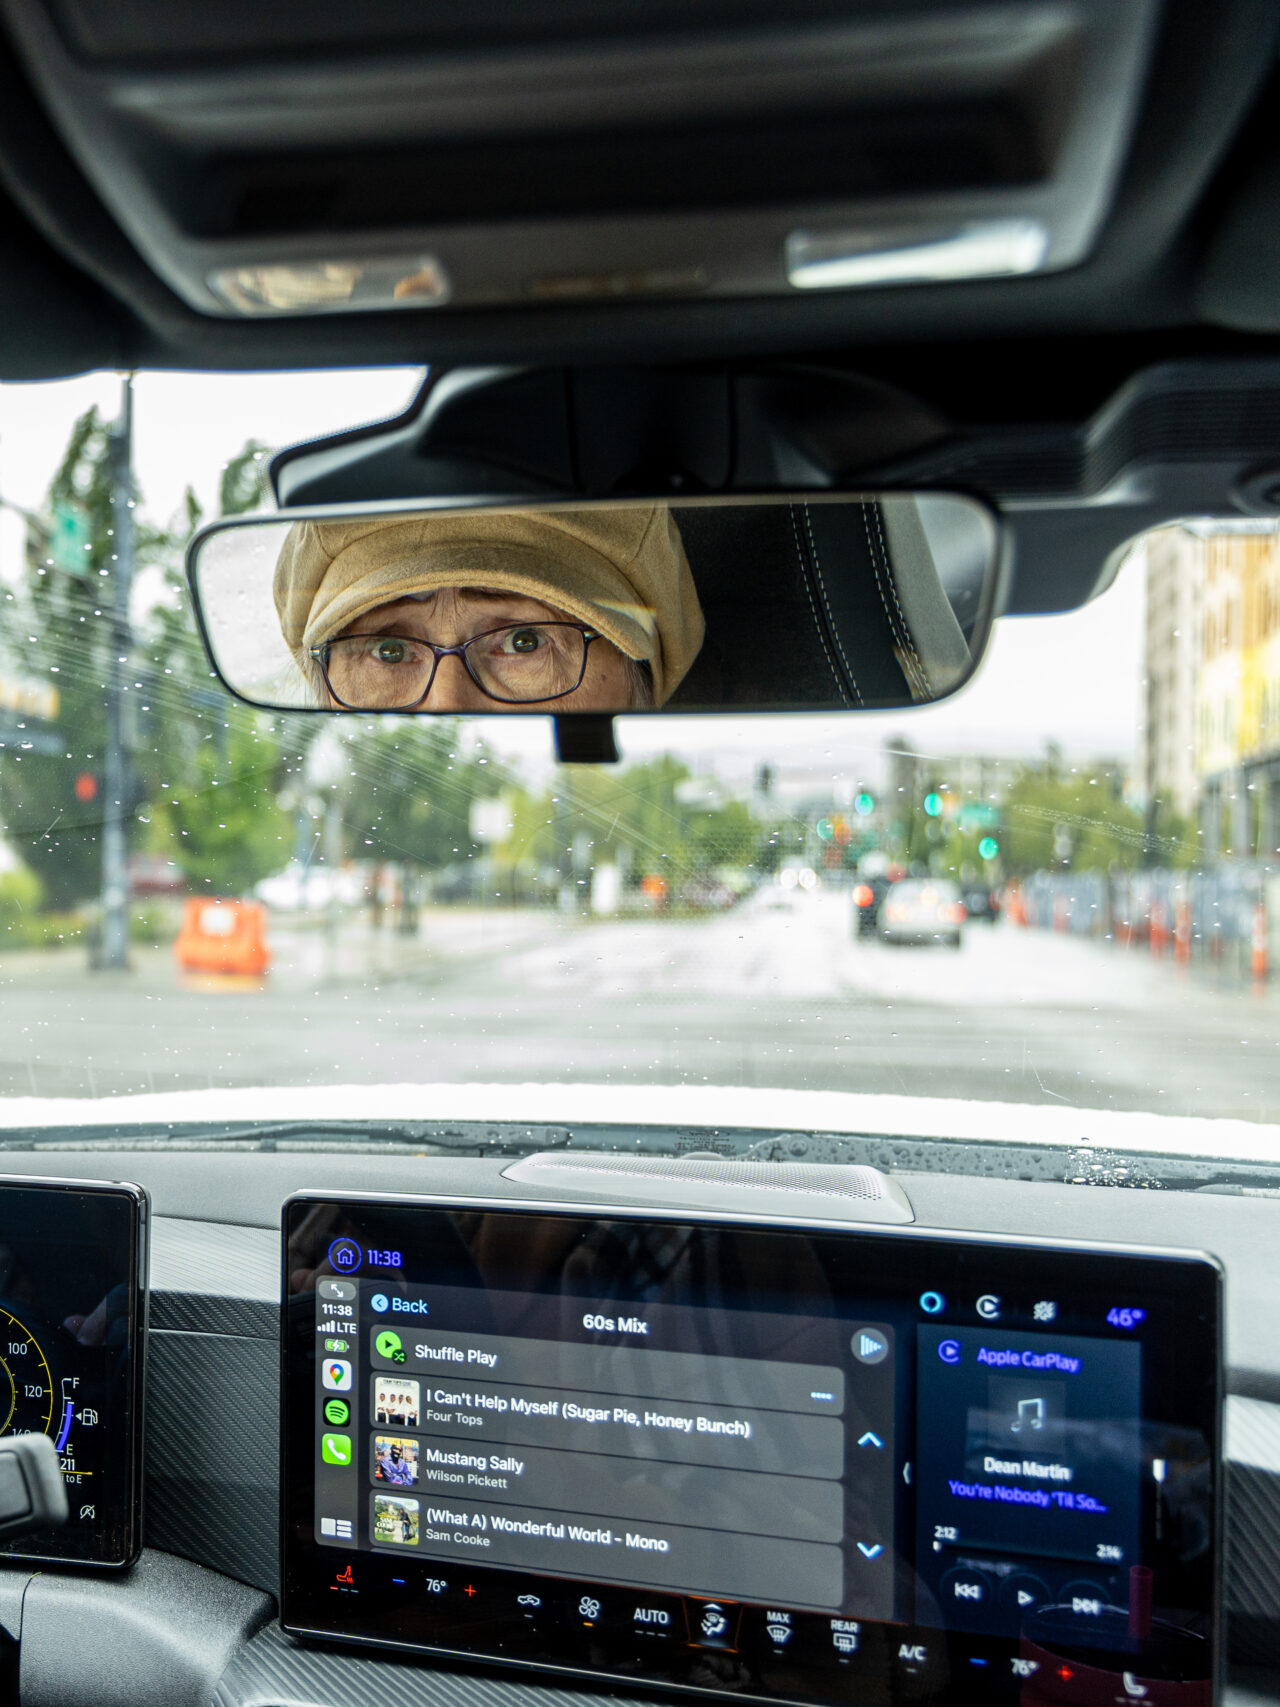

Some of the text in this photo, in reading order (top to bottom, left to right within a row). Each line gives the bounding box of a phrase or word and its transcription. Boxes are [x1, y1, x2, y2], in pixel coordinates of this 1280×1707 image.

[368, 1249, 402, 1266] 11:38
[322, 1303, 353, 1316] 11:38
[392, 1298, 428, 1314] Back
[583, 1314, 648, 1334] 60s Mix
[1106, 1307, 1146, 1328] 46°
[337, 1322, 357, 1334] LTE
[8, 1343, 28, 1355] 100
[414, 1344, 498, 1368] Shuffle Play
[977, 1348, 1079, 1373] Apple CarPlay
[24, 1385, 43, 1398] 120
[72, 1378, 80, 1389] F
[426, 1389, 751, 1438] I Can't Help Myself (Sugar Pie, Honey Bunch)
[426, 1410, 483, 1426] Four Tops
[66, 1444, 74, 1456] E
[60, 1458, 75, 1471] 211
[426, 1449, 524, 1475] Mustang Sally
[984, 1457, 1072, 1480] Dean Martin
[66, 1474, 75, 1483] to
[77, 1475, 83, 1484] E
[426, 1469, 508, 1489] Wilson Pickett
[948, 1480, 992, 1499] You're
[995, 1486, 1049, 1507] Nobody
[426, 1529, 490, 1547] Sam Cooke
[427, 1508, 469, 1526] (What
[471, 1514, 487, 1531] A)
[491, 1516, 564, 1538] Wonderful
[568, 1526, 612, 1545] World
[625, 1533, 669, 1551] Mono
[426, 1578, 447, 1593] 76°
[634, 1608, 669, 1625] AUTO
[767, 1612, 790, 1624] MAX
[831, 1619, 858, 1634] REAR
[899, 1644, 927, 1661] A/C
